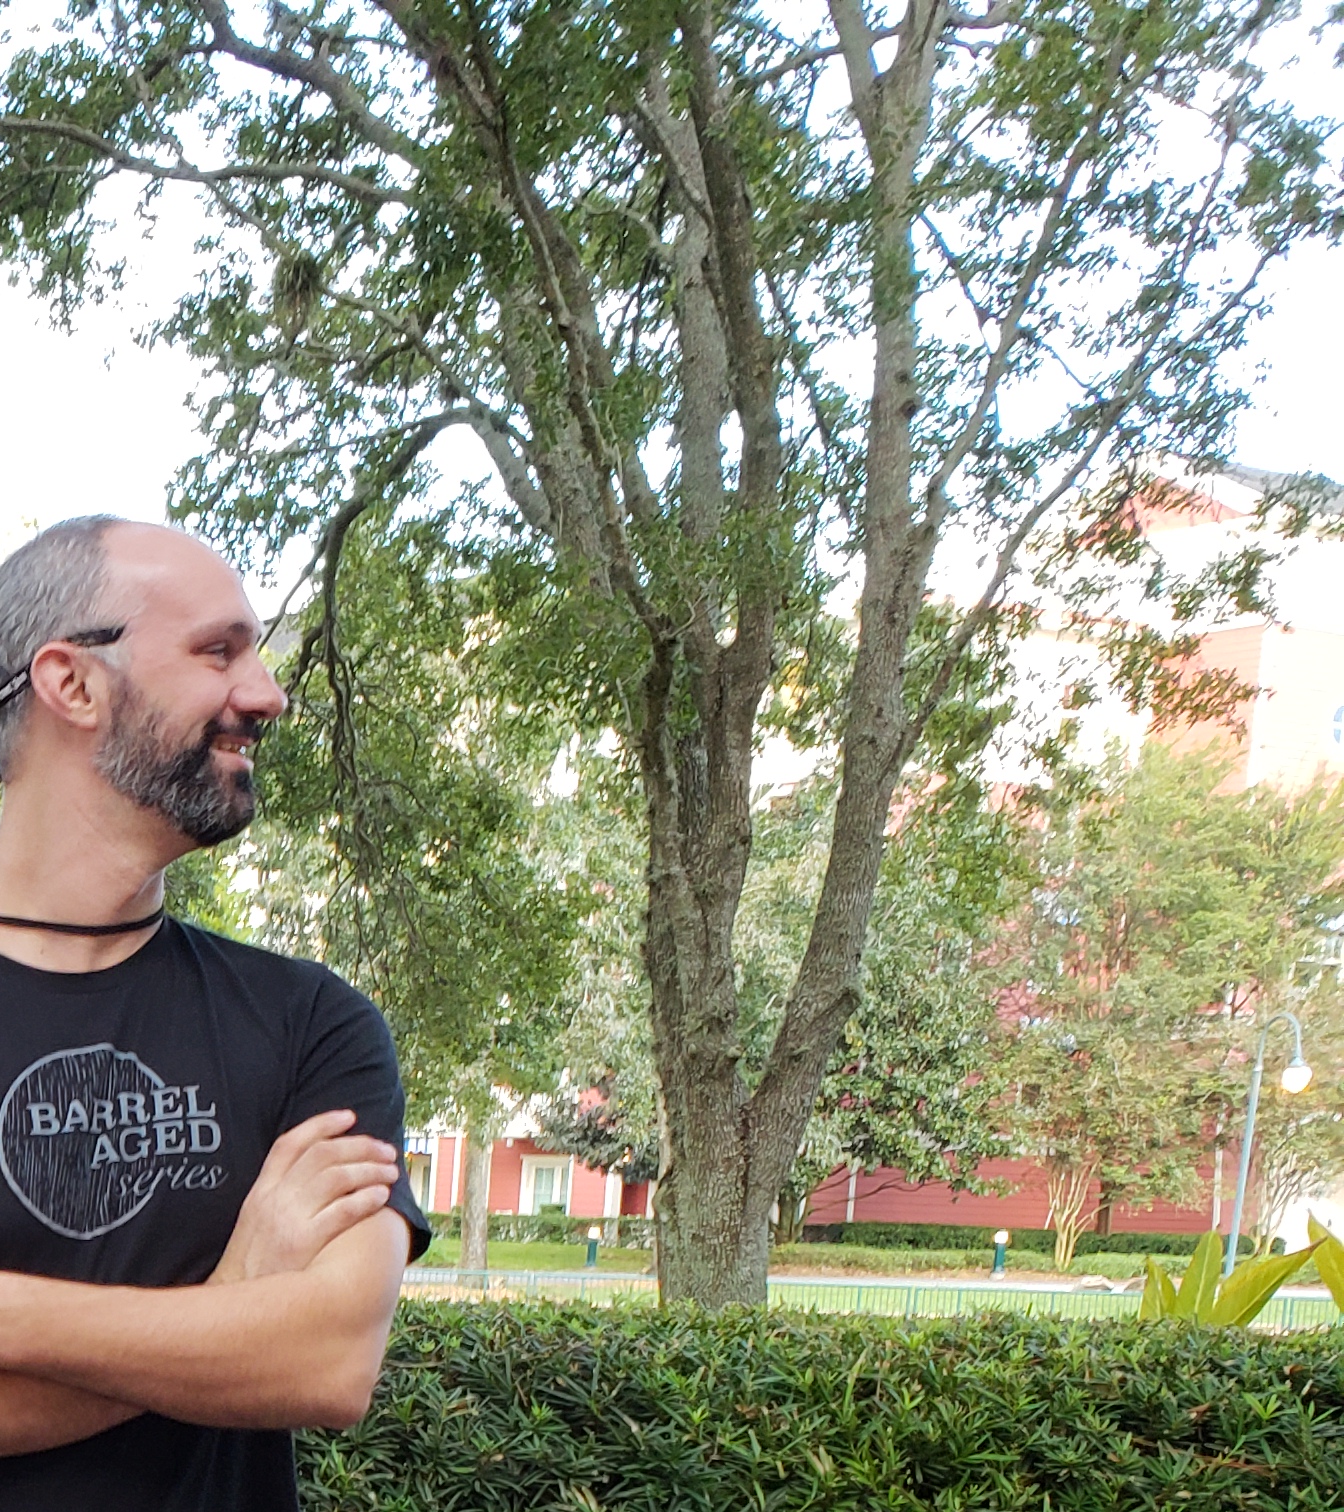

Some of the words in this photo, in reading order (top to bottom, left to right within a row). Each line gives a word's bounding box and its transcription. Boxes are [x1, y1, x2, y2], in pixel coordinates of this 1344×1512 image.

[25, 1084, 216, 1136] BARREL
[90, 1117, 222, 1170] AGED
[115, 1157, 229, 1198] series
